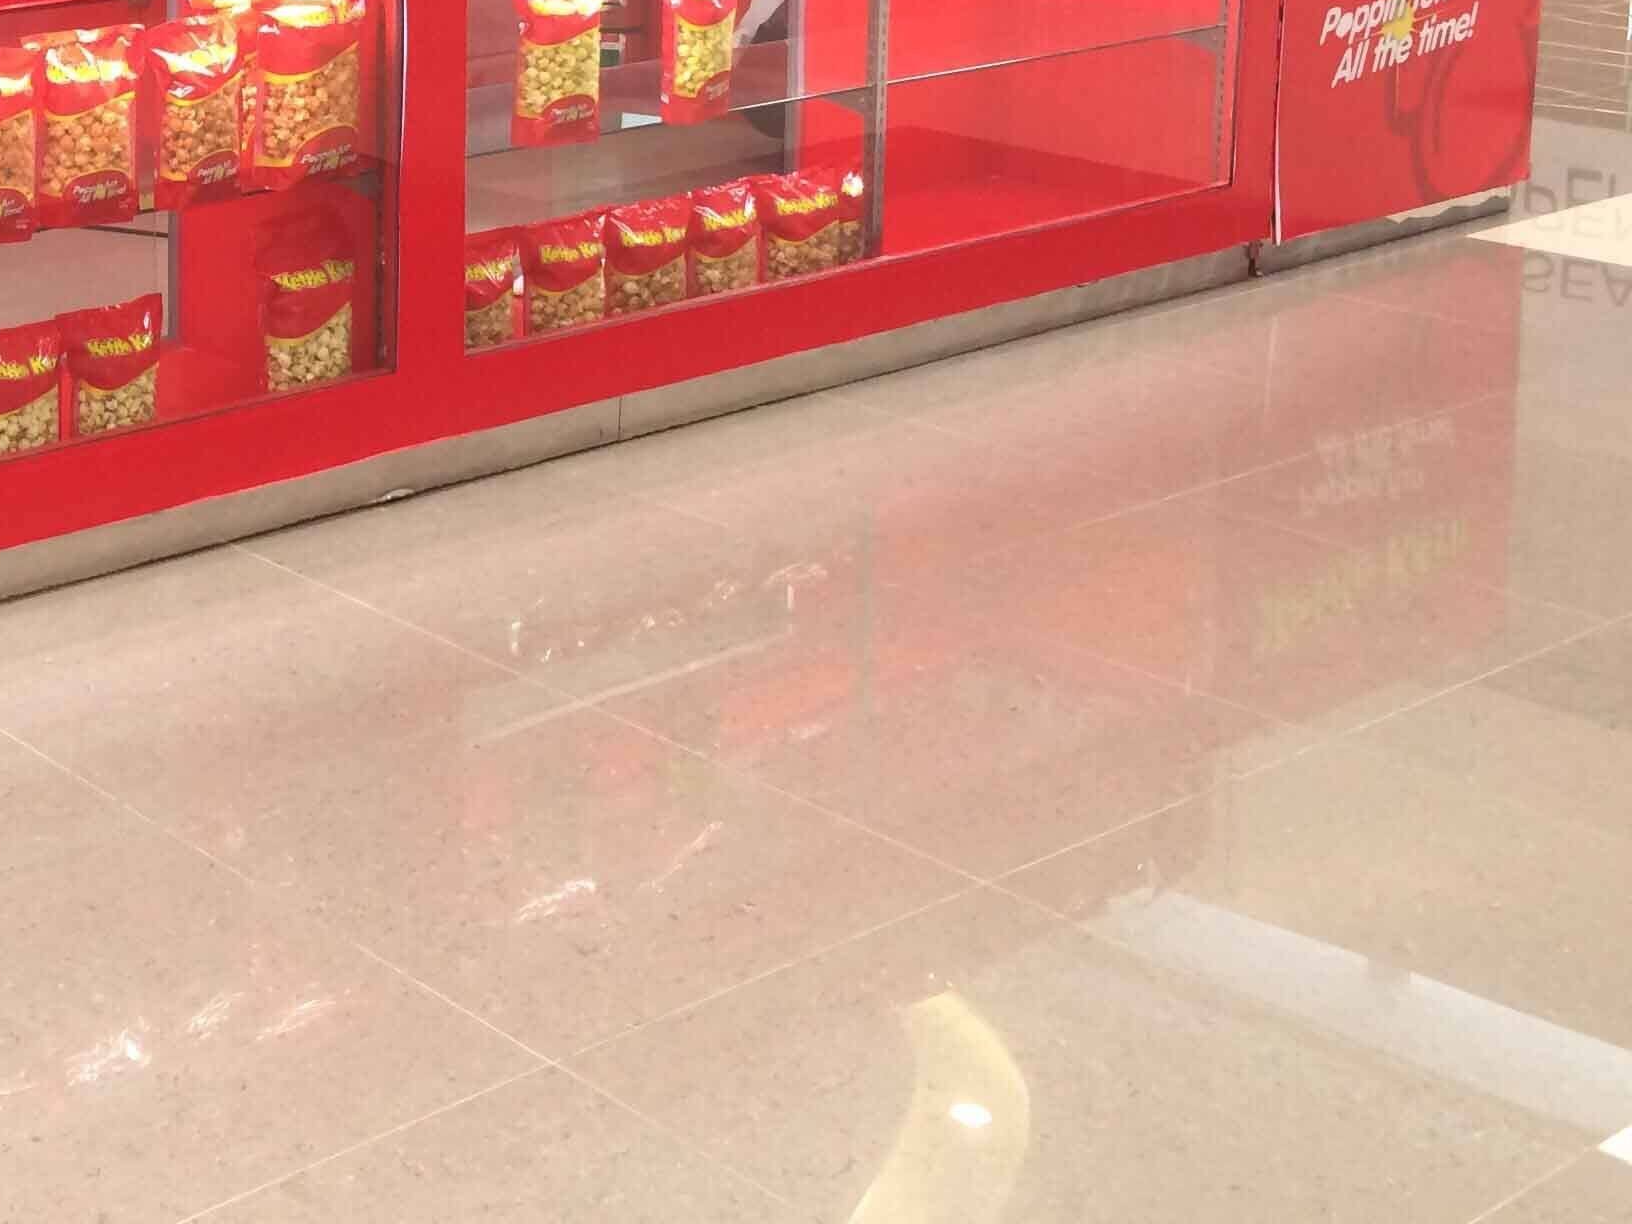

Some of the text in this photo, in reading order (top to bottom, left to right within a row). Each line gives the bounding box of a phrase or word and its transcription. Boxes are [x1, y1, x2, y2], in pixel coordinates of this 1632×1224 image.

[1331, 2, 1480, 88] All the time!
